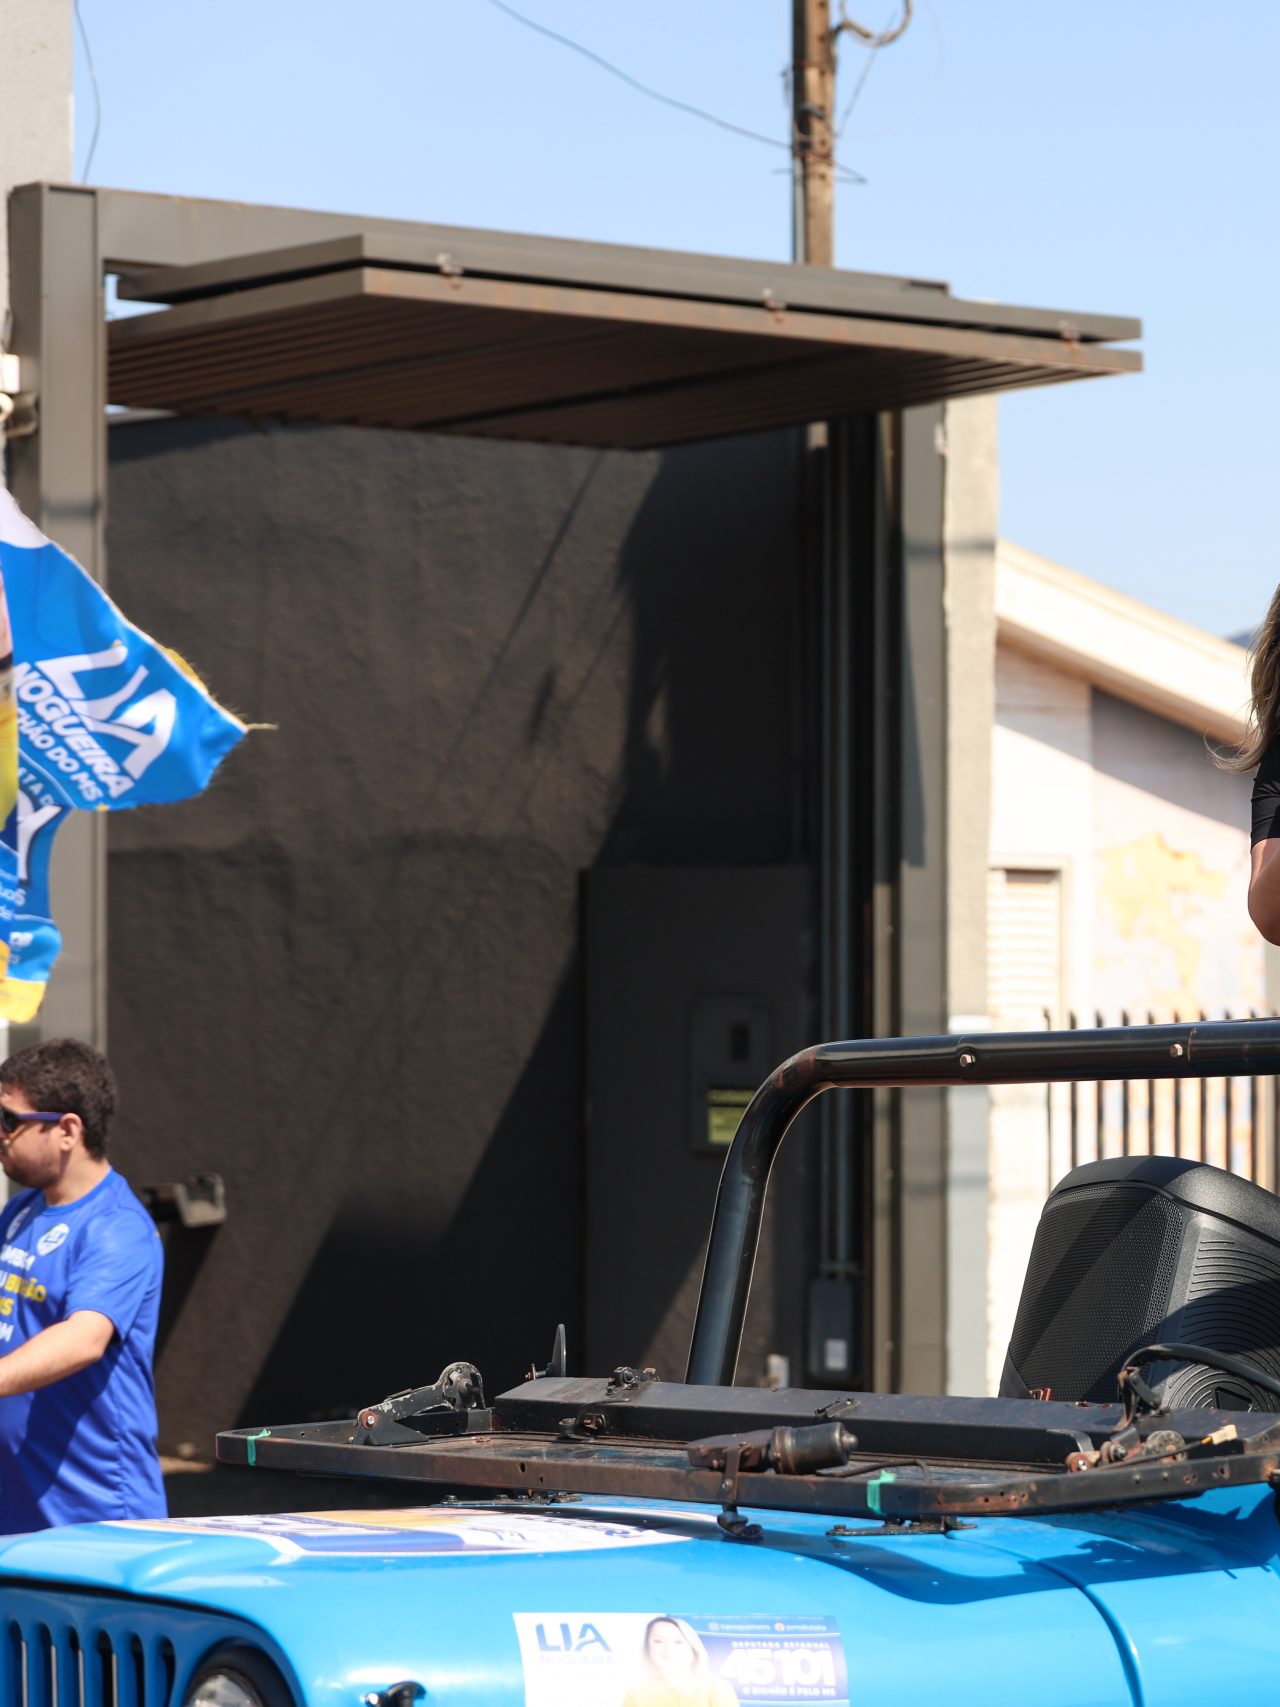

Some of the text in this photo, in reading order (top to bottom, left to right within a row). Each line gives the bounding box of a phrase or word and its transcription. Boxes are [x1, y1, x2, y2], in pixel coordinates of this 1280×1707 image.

[46, 746, 80, 773] DO
[535, 1622, 612, 1652] LIA
[732, 1641, 830, 1649] DEPUTADA ESTADUAL
[720, 1649, 836, 1686] 45101
